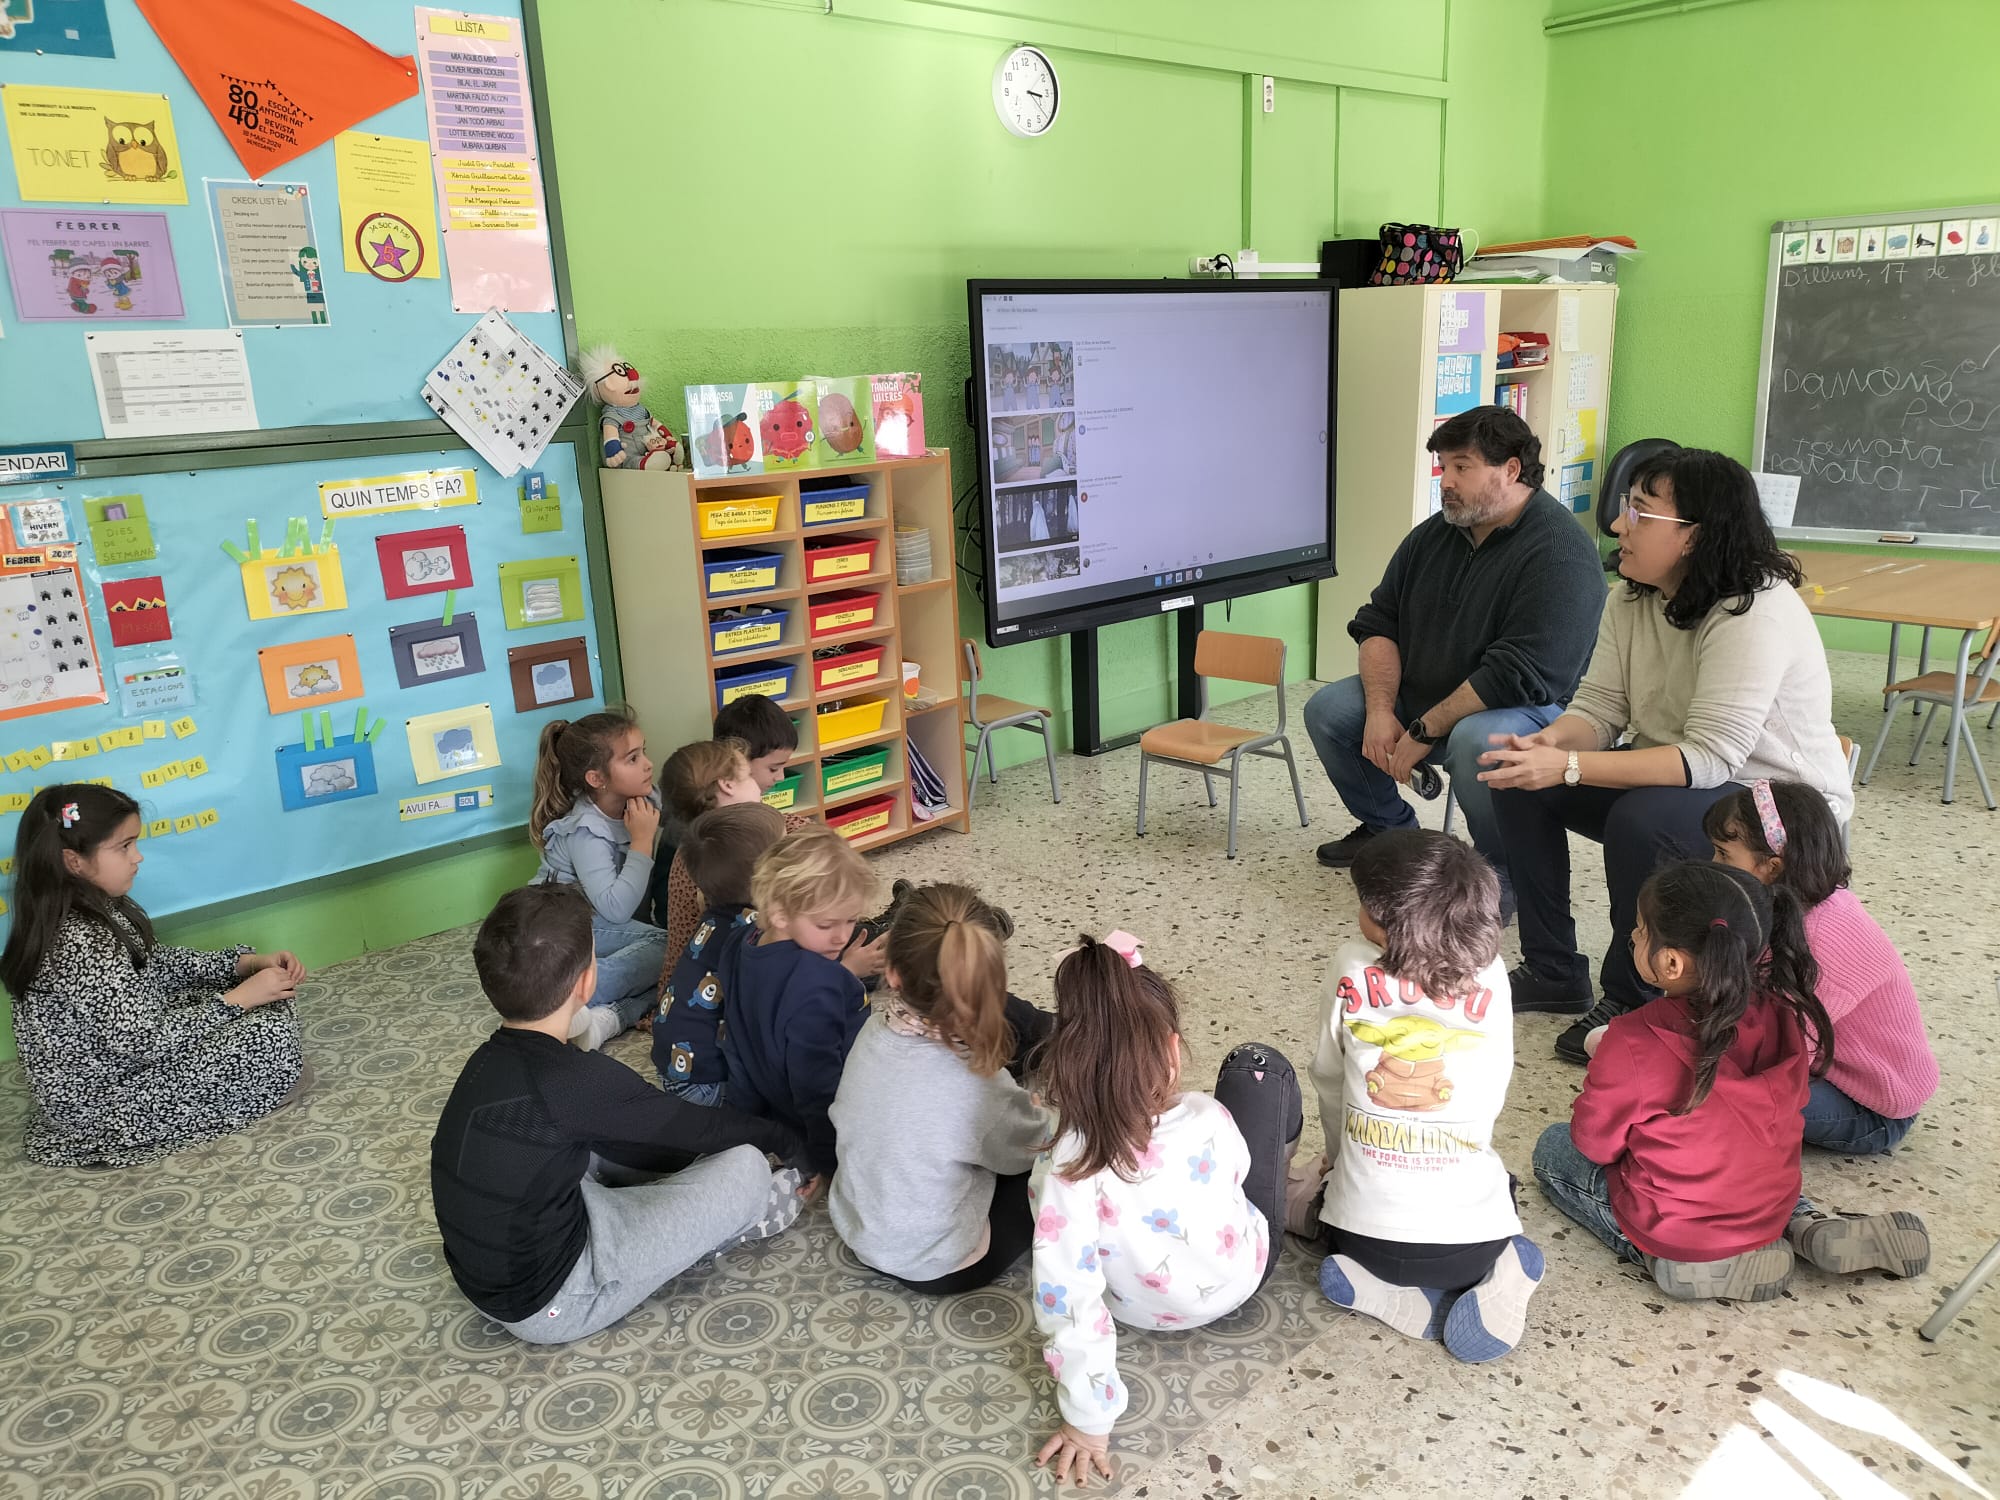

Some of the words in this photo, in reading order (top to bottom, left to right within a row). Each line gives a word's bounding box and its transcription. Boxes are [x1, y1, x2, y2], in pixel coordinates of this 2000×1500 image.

[455, 21, 485, 34] LLISTA
[1012, 61, 1019, 70] 11
[1021, 57, 1030, 67] 12
[1034, 62, 1038, 71] 1
[1004, 72, 1013, 81] 10
[1041, 73, 1046, 83] 2
[228, 84, 258, 109] 80
[1004, 87, 1009, 96] 9
[1045, 89, 1049, 98] 3
[267, 100, 298, 117] ESCOLA
[228, 104, 259, 130] 40
[1016, 114, 1021, 124] 7
[1036, 114, 1041, 124] 5
[264, 118, 295, 136] REVISTA
[289, 118, 304, 128] NAT
[1027, 118, 1032, 128] 6
[258, 125, 267, 134] EL
[269, 128, 298, 146] PORTAL
[27, 148, 91, 168] TONET
[56, 220, 121, 231] FEBRER
[383, 245, 395, 262] 5
[1784, 265, 1871, 287] Dilluns,
[1880, 262, 1909, 284] 17
[1928, 258, 1949, 280] de
[331, 489, 372, 509] QUIN
[375, 483, 430, 503] TEMPS
[435, 478, 462, 496] FA?
[29, 522, 59, 531] HIVERN
[105, 526, 134, 538] DIES
[5, 555, 42, 566] FEBRER
[131, 681, 185, 697] ESTACIONS
[83, 743, 89, 752] 6
[176, 721, 190, 732] 10
[189, 761, 202, 773] 20
[405, 800, 427, 814] AVUI
[459, 797, 474, 806] SOL
[1363, 1147, 1377, 1159] THE
[1379, 1152, 1408, 1164] FORCE
[1412, 1156, 1421, 1165] IS
[1377, 1160, 1393, 1168] WITH
